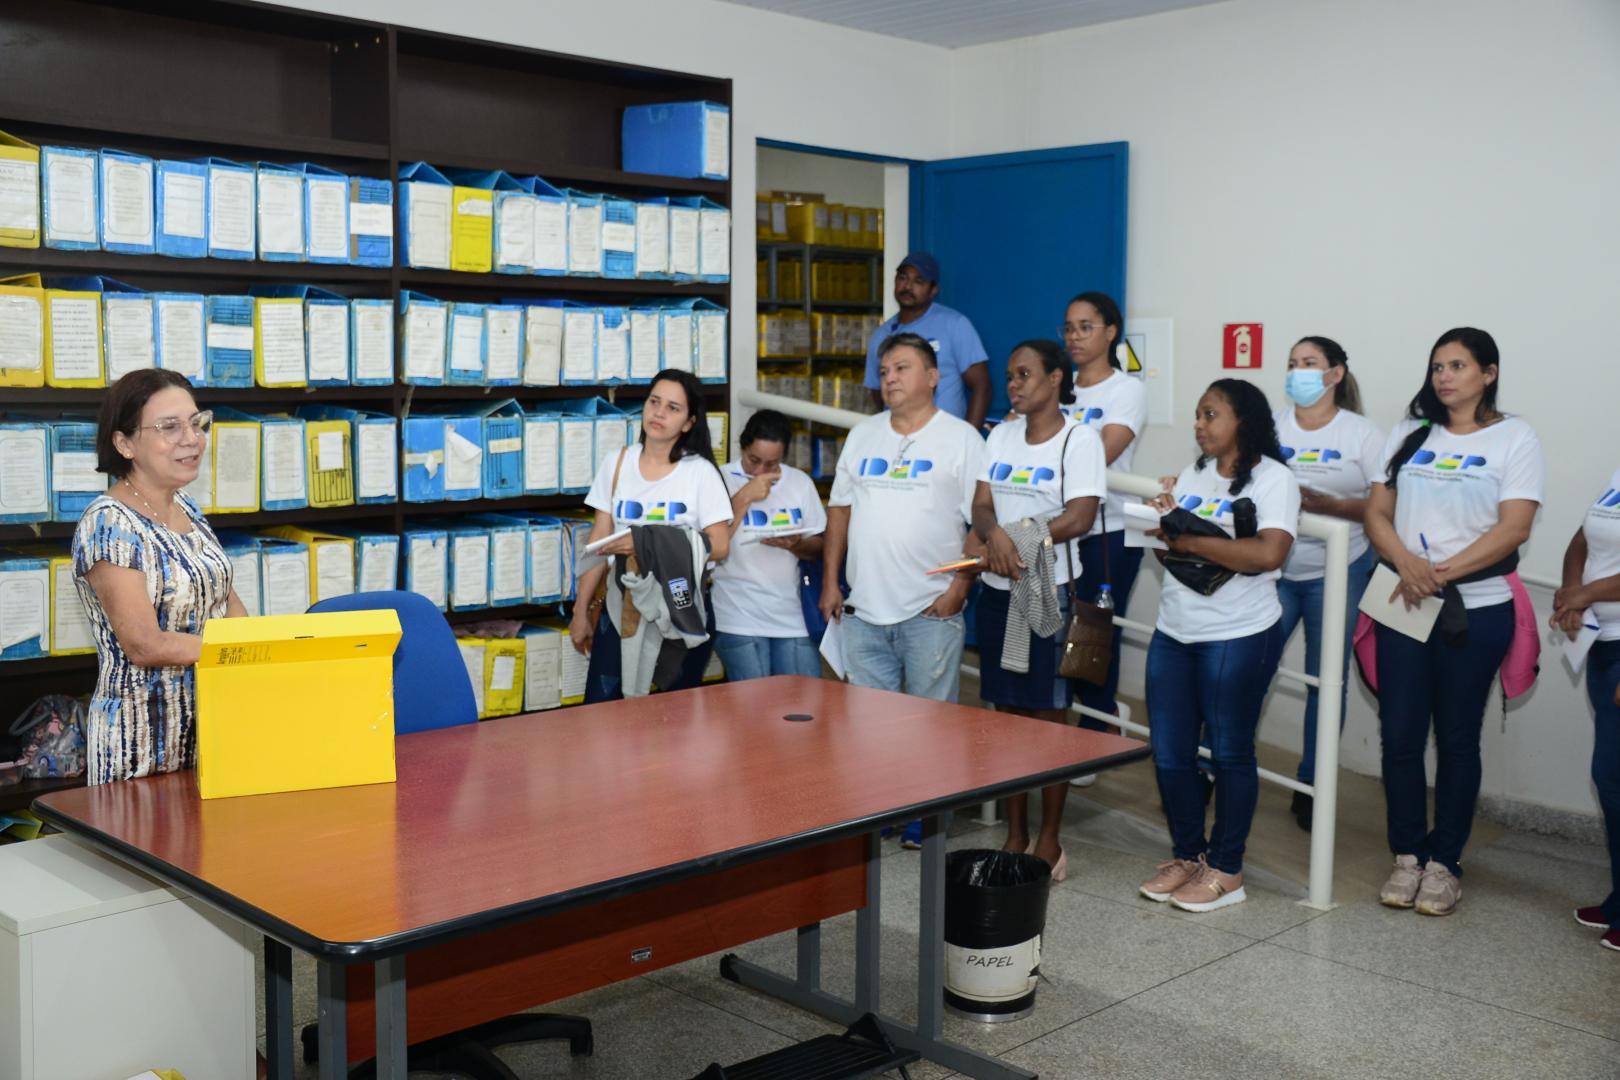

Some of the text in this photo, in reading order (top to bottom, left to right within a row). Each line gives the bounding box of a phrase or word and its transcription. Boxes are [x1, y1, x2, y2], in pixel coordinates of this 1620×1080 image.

[859, 458, 933, 478] IDEP
[989, 462, 1055, 485] IDEP
[616, 500, 688, 521] IDEP
[966, 955, 1014, 968] PAPEL
